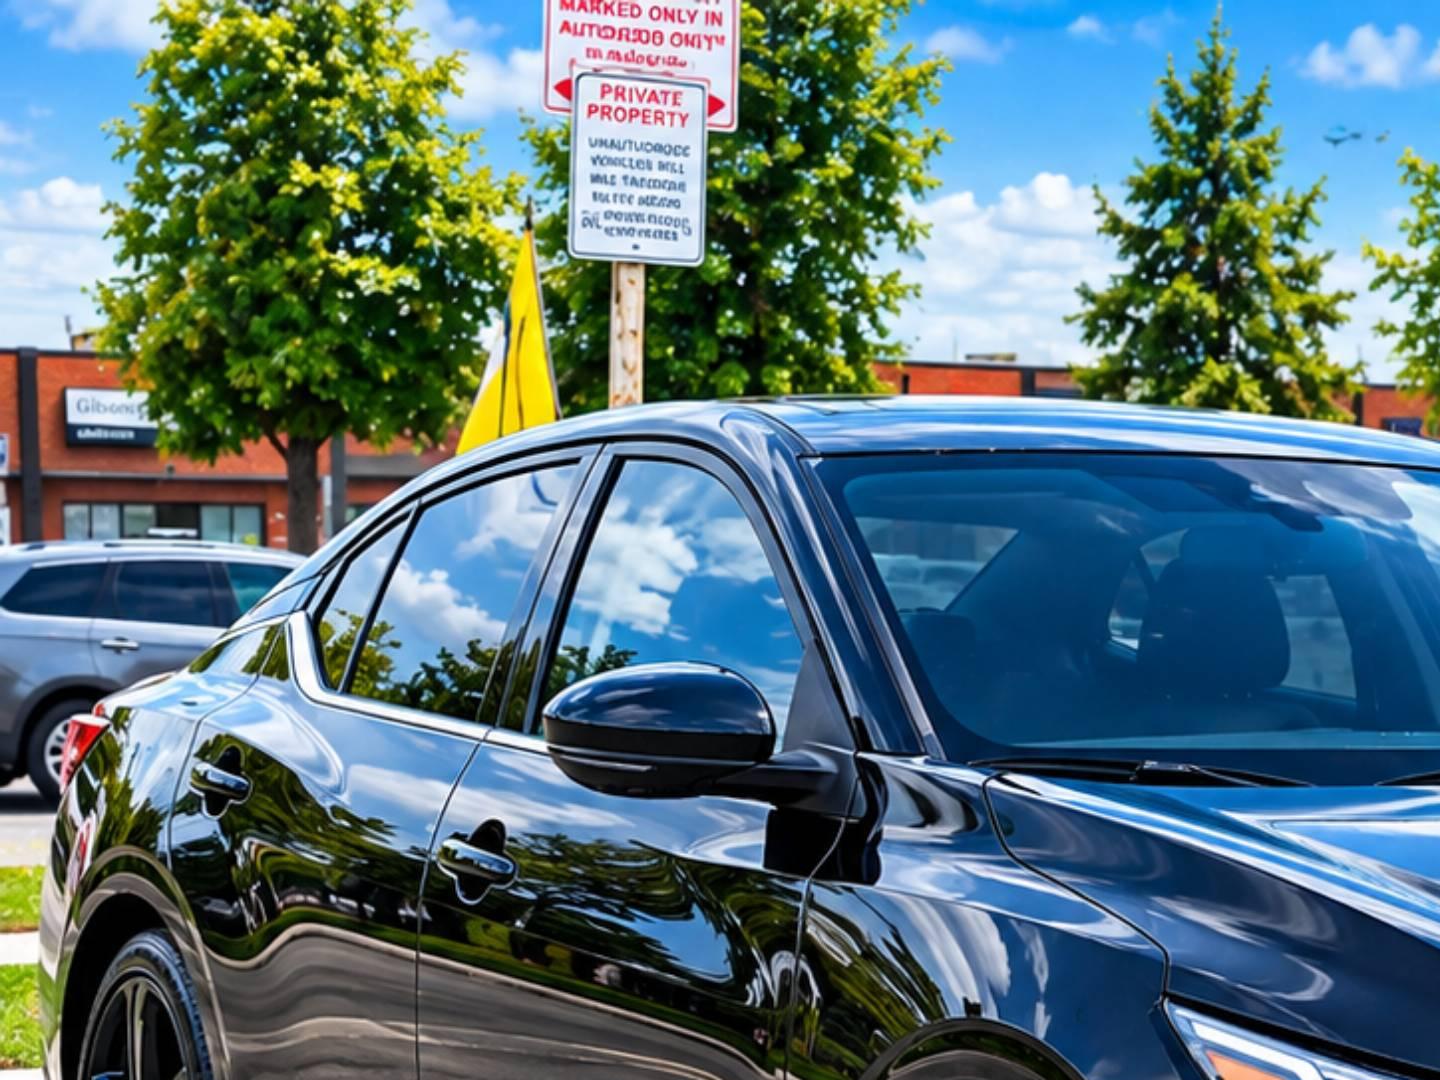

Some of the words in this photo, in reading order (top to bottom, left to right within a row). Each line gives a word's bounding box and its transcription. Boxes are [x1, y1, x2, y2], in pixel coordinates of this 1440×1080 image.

[559, 0, 642, 19] MARKED
[648, 6, 699, 24] ONLY
[705, 10, 723, 27] IN
[600, 83, 684, 107] PRIVATE
[586, 104, 690, 128] PROPERTY
